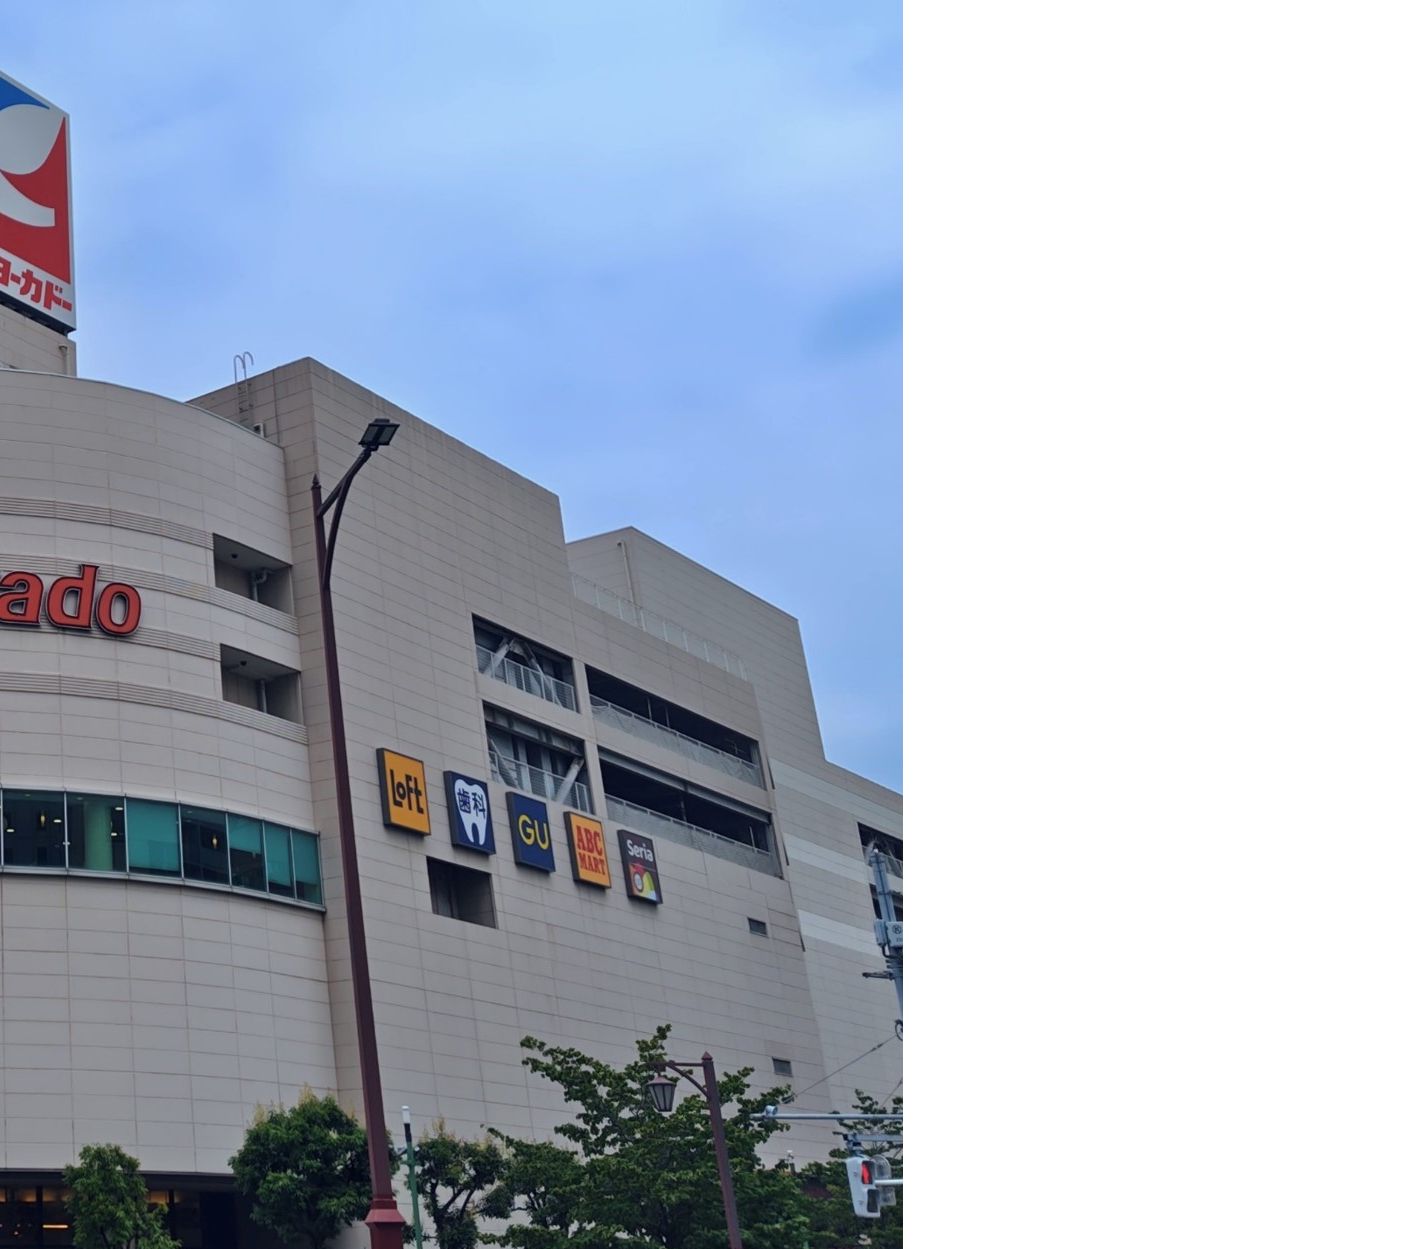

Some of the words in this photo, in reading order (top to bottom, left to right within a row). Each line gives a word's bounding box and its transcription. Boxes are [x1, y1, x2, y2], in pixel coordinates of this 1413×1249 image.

[456, 787, 486, 819] 歯科
[518, 814, 549, 850] GU
[575, 824, 603, 857] ABC
[578, 852, 606, 876] MART
[626, 839, 654, 862] Seria
